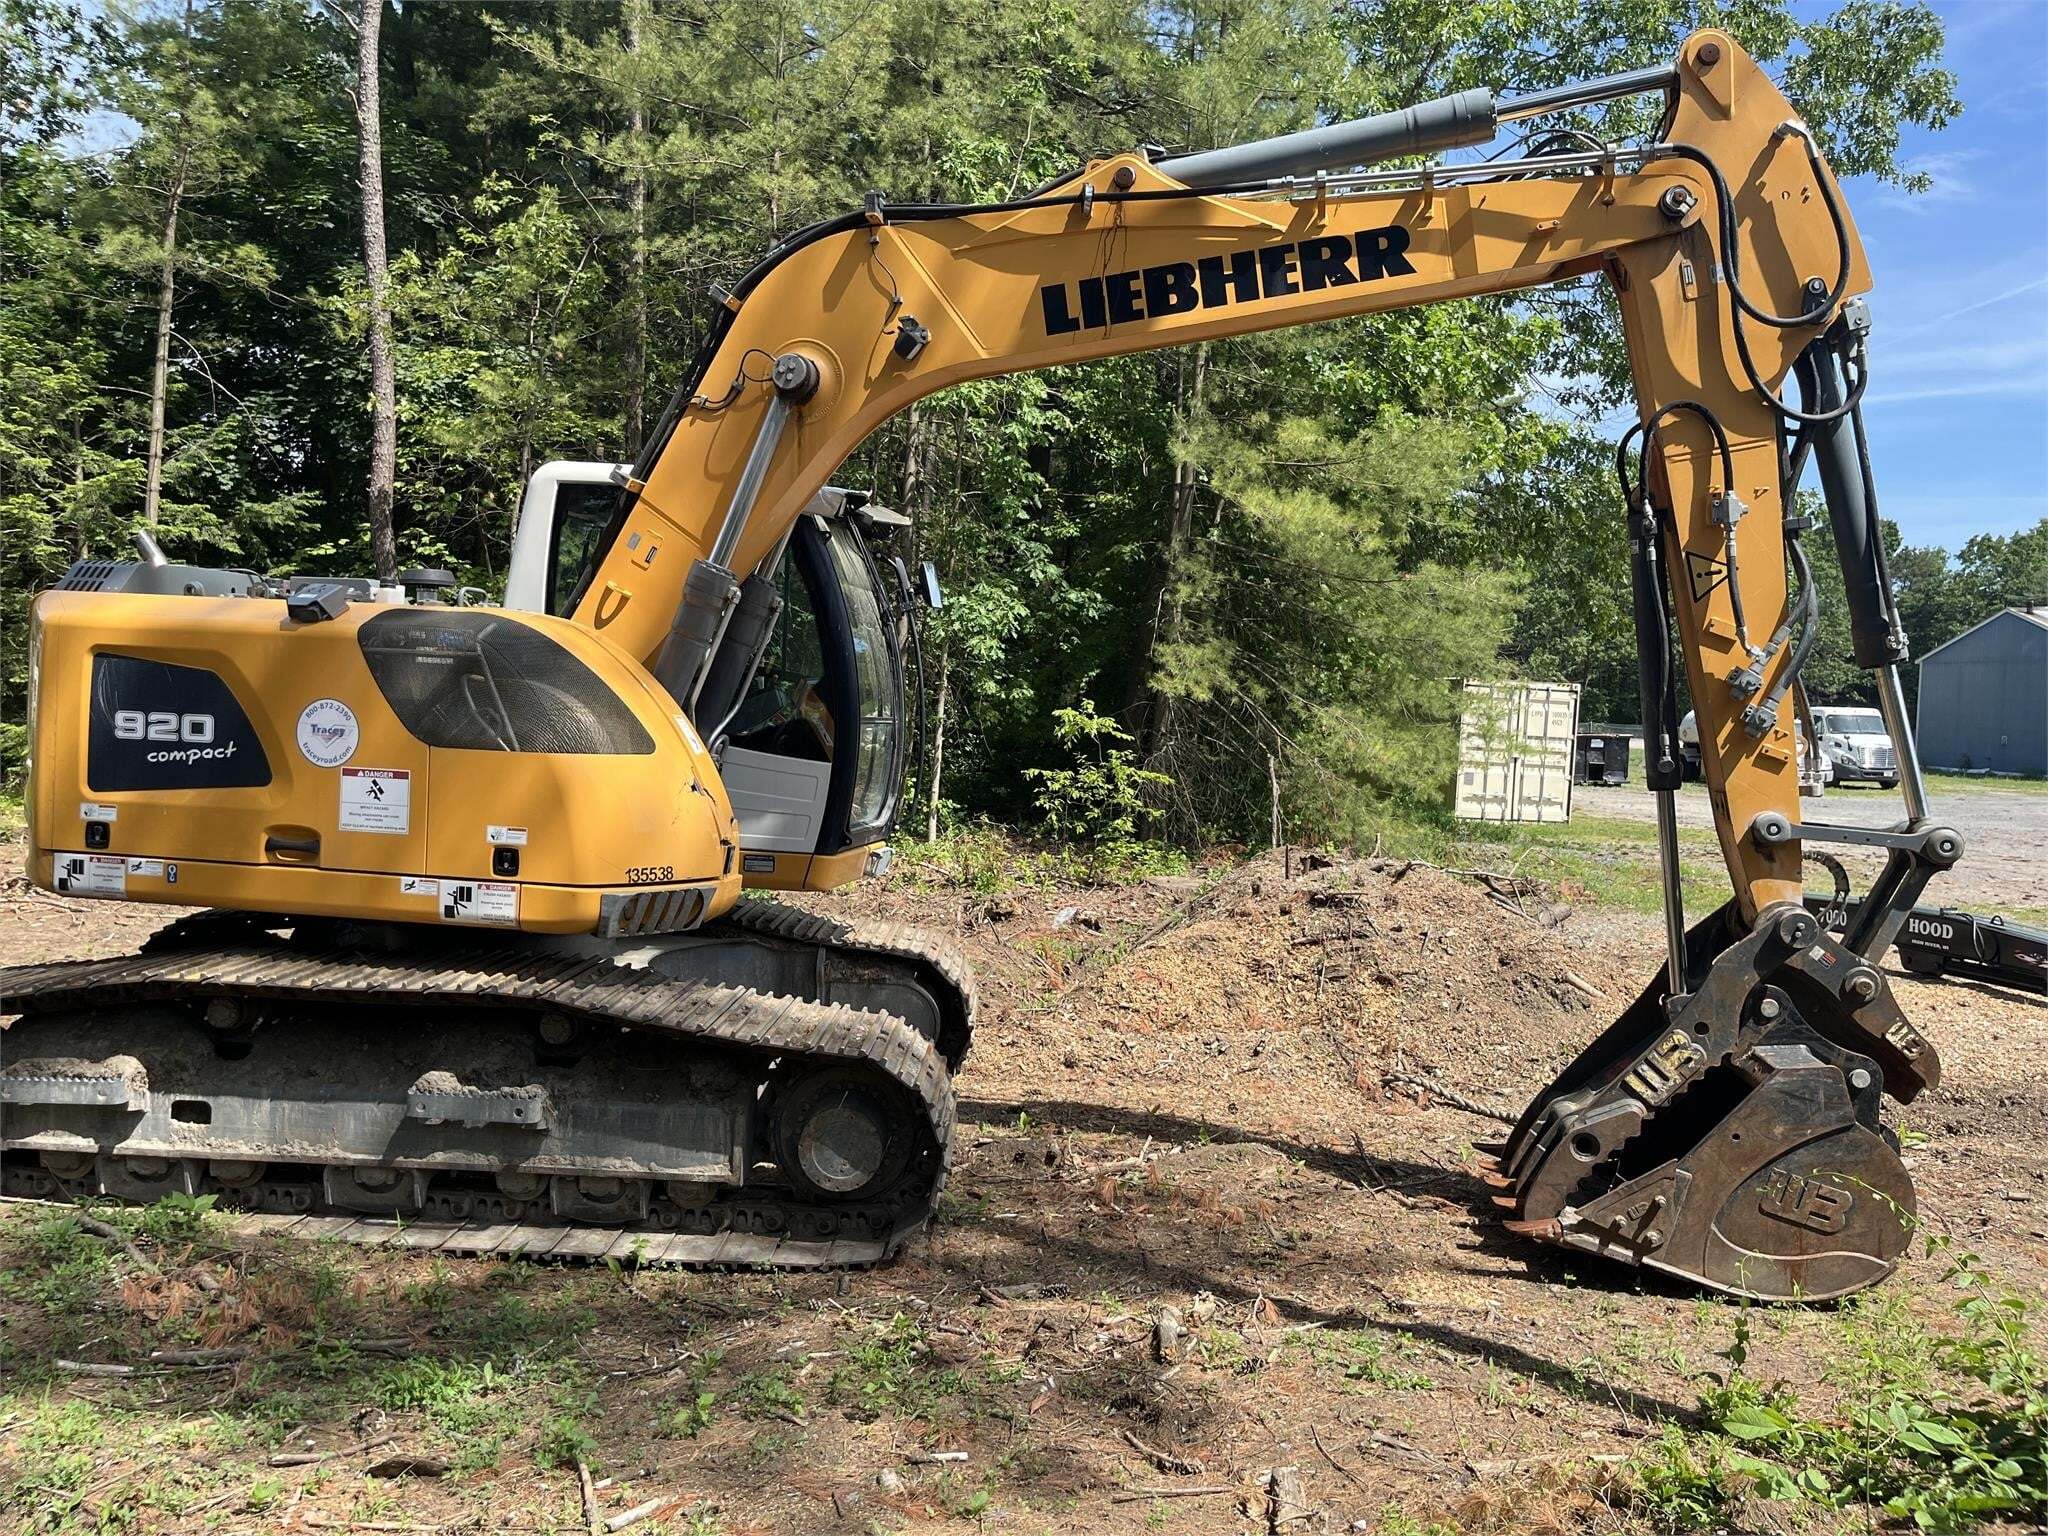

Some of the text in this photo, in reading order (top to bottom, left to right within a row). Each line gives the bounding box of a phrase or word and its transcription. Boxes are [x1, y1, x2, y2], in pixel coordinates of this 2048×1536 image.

[1040, 224, 1418, 337] LIEBHERR
[114, 710, 215, 744] 920
[311, 724, 346, 737] Tracey
[147, 741, 237, 765] compact
[303, 742, 352, 764] traceyroad.com
[364, 770, 394, 779] DANGER
[625, 866, 674, 883] 135538
[1908, 918, 1953, 939] HOOD
